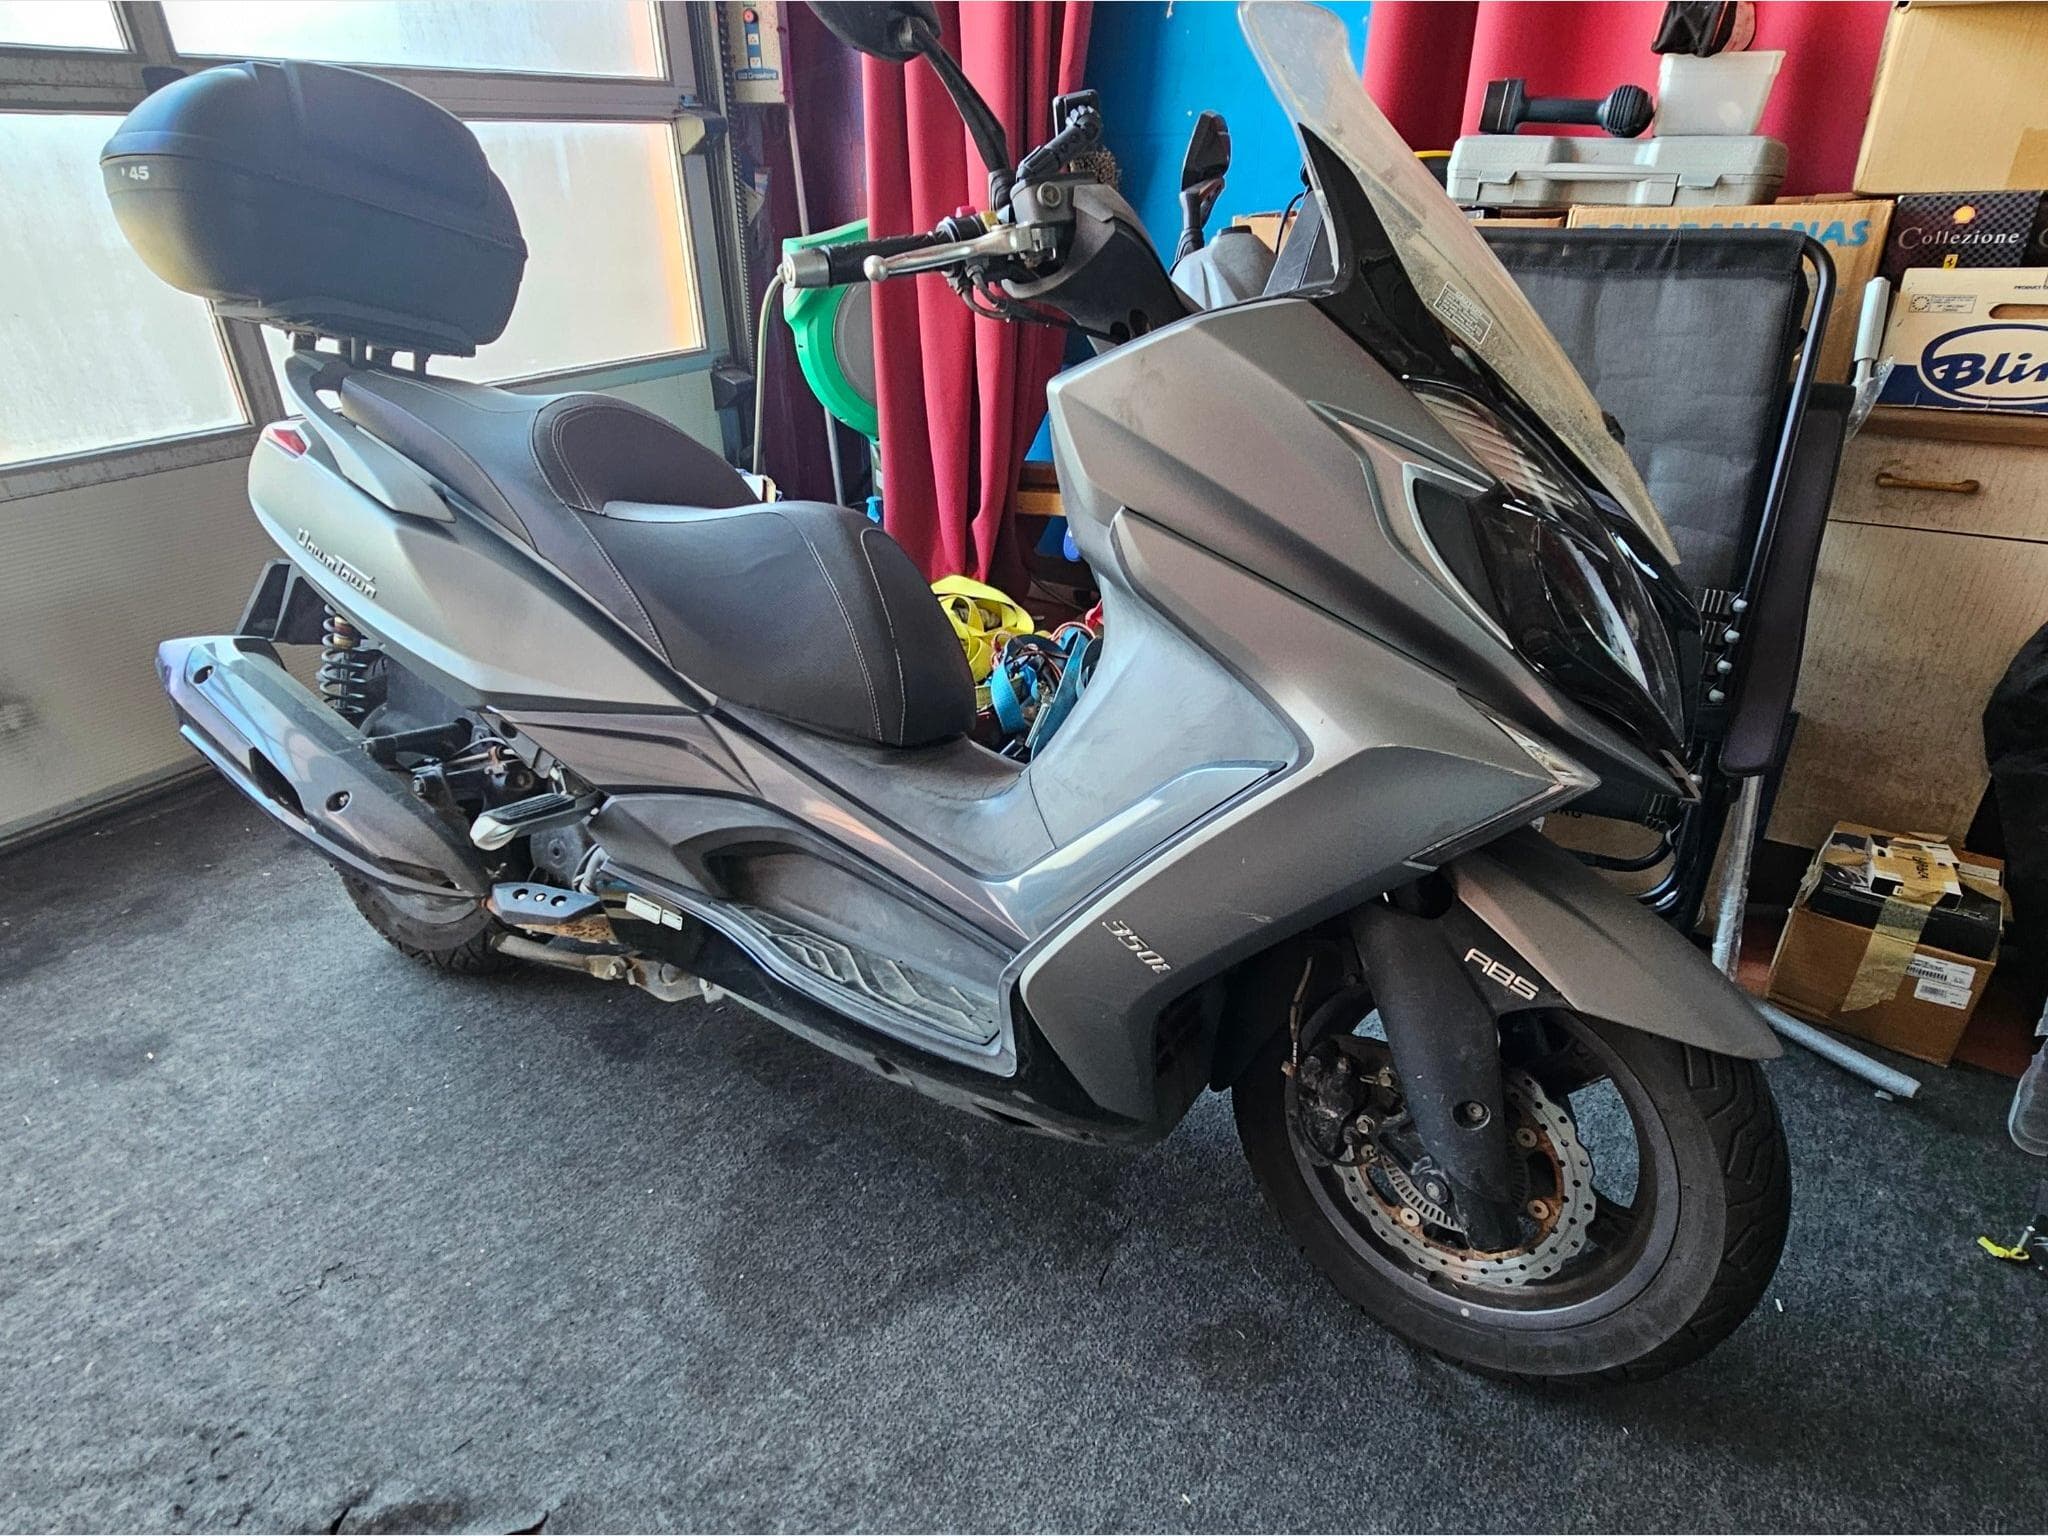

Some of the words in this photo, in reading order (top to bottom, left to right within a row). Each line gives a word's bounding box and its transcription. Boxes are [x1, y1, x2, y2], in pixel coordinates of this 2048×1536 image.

[129, 165, 149, 180] 45
[1898, 226, 2020, 250] Collezione
[1463, 947, 1540, 1001] ABS
